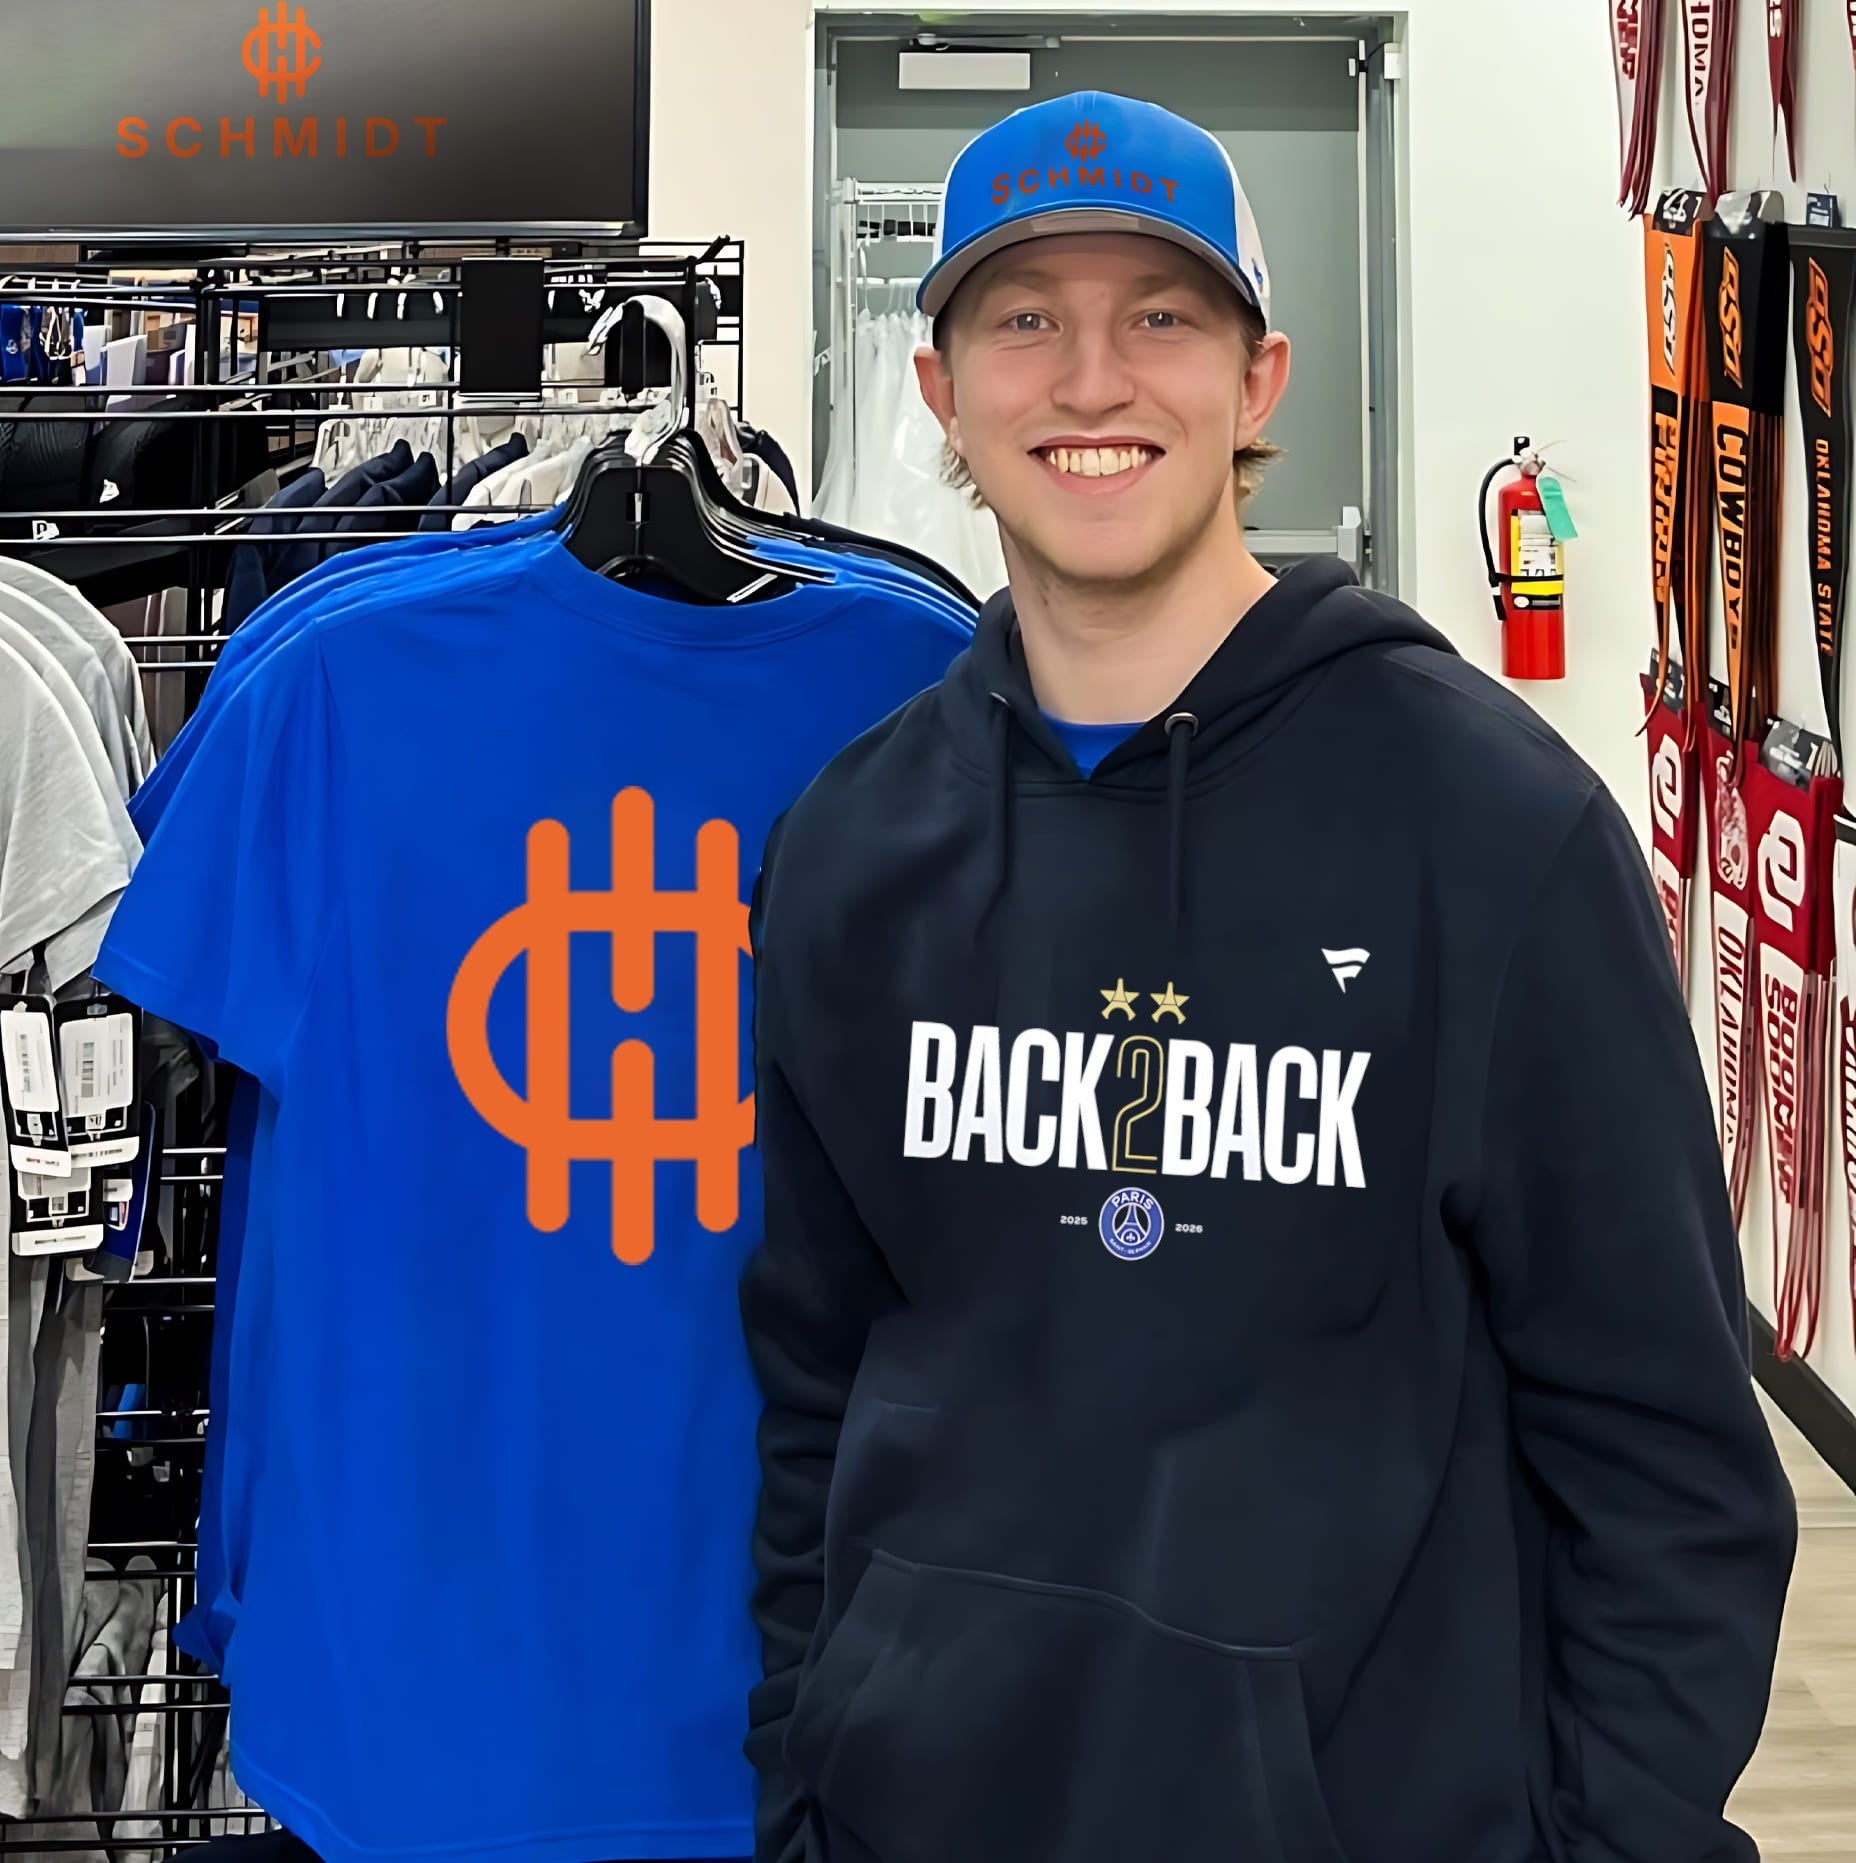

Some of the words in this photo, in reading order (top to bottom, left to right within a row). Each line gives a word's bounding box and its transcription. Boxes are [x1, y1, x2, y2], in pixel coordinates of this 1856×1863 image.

[116, 116, 447, 158] SCHMIDT
[991, 167, 1179, 204] SCHMIDT
[1815, 438, 1832, 571] OKLAHOMA
[903, 1021, 1372, 1188] BACK2BACK
[1111, 1191, 1154, 1210] PARIS
[1060, 1215, 1088, 1225] 2025
[1175, 1223, 1204, 1233] 2026
